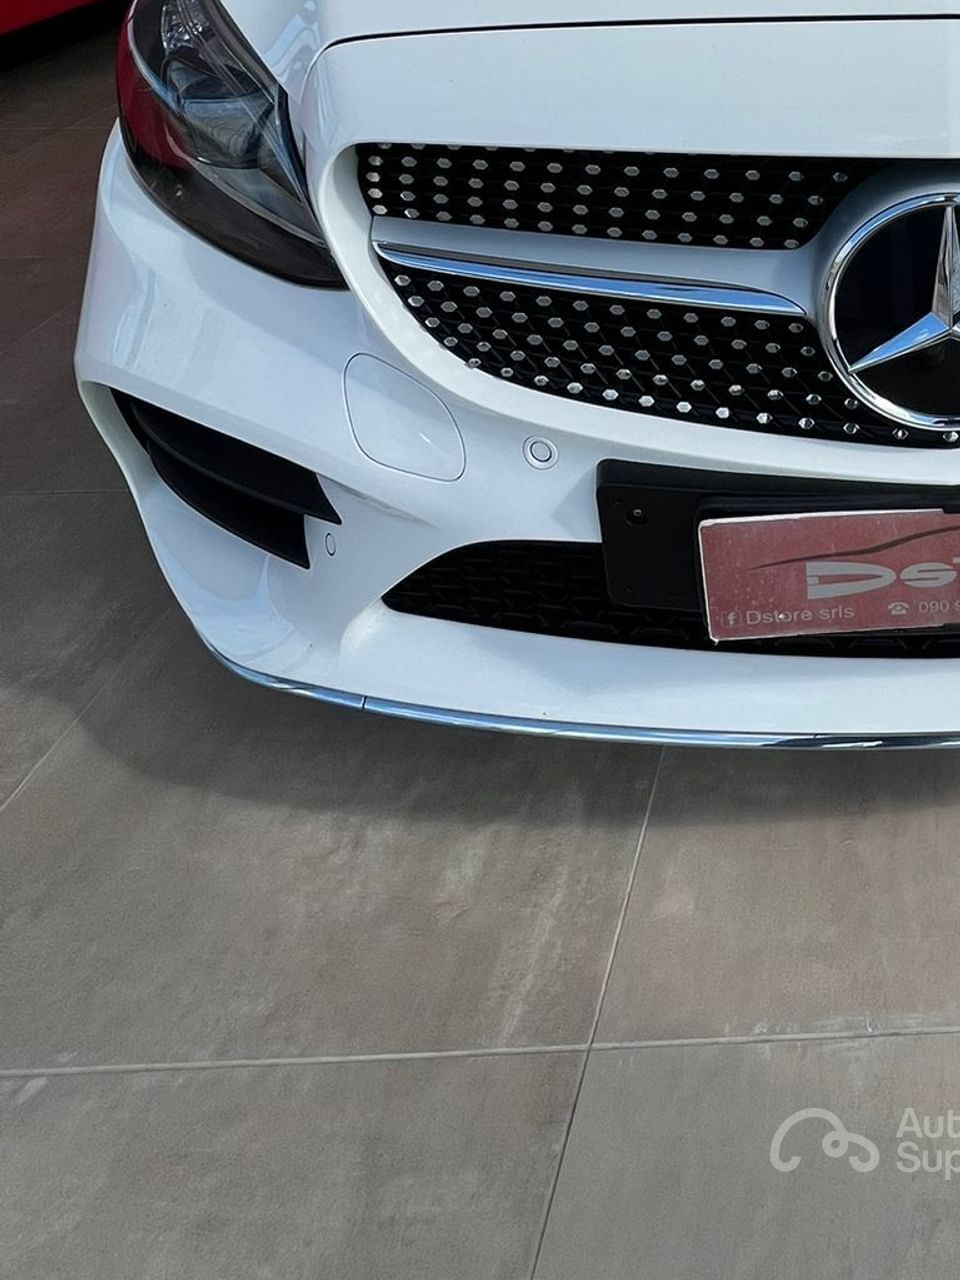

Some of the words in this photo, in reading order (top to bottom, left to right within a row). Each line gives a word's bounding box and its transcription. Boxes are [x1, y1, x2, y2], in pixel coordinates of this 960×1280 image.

[746, 607, 813, 626] Dstore
[819, 604, 856, 621] srls
[918, 600, 950, 614] 090
